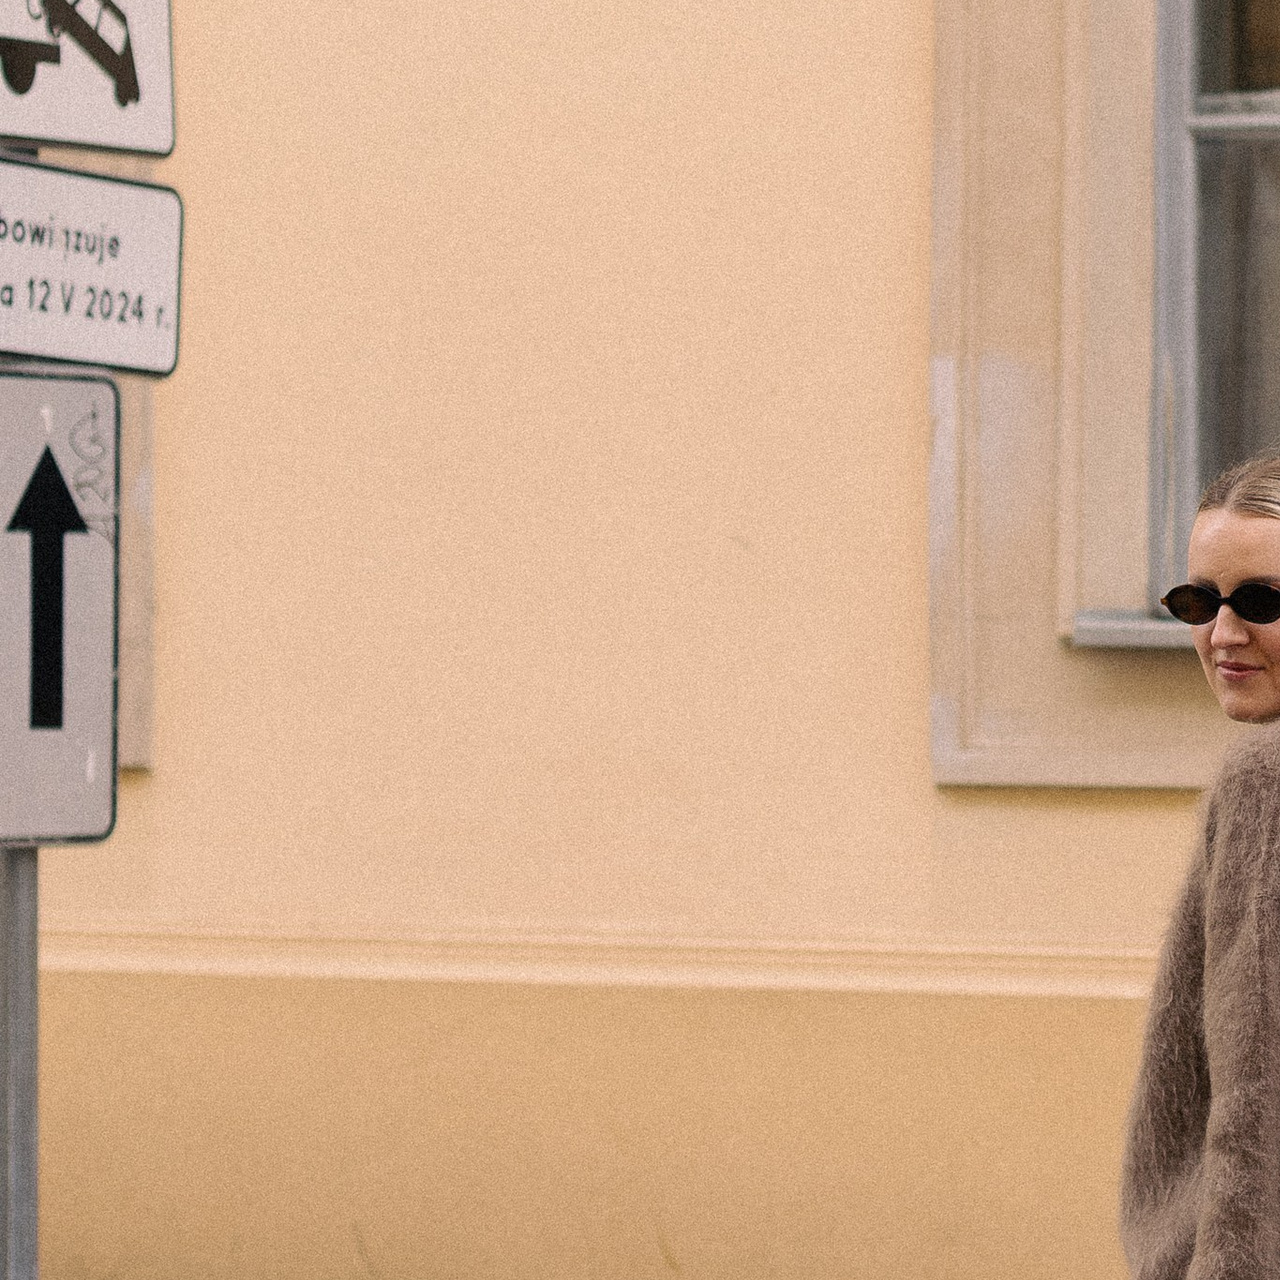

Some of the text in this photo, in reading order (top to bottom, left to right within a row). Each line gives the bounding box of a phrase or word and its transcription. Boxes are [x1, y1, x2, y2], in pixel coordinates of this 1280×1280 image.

[27, 276, 51, 312] 12
[60, 280, 75, 314] V
[85, 285, 145, 324] 2024
